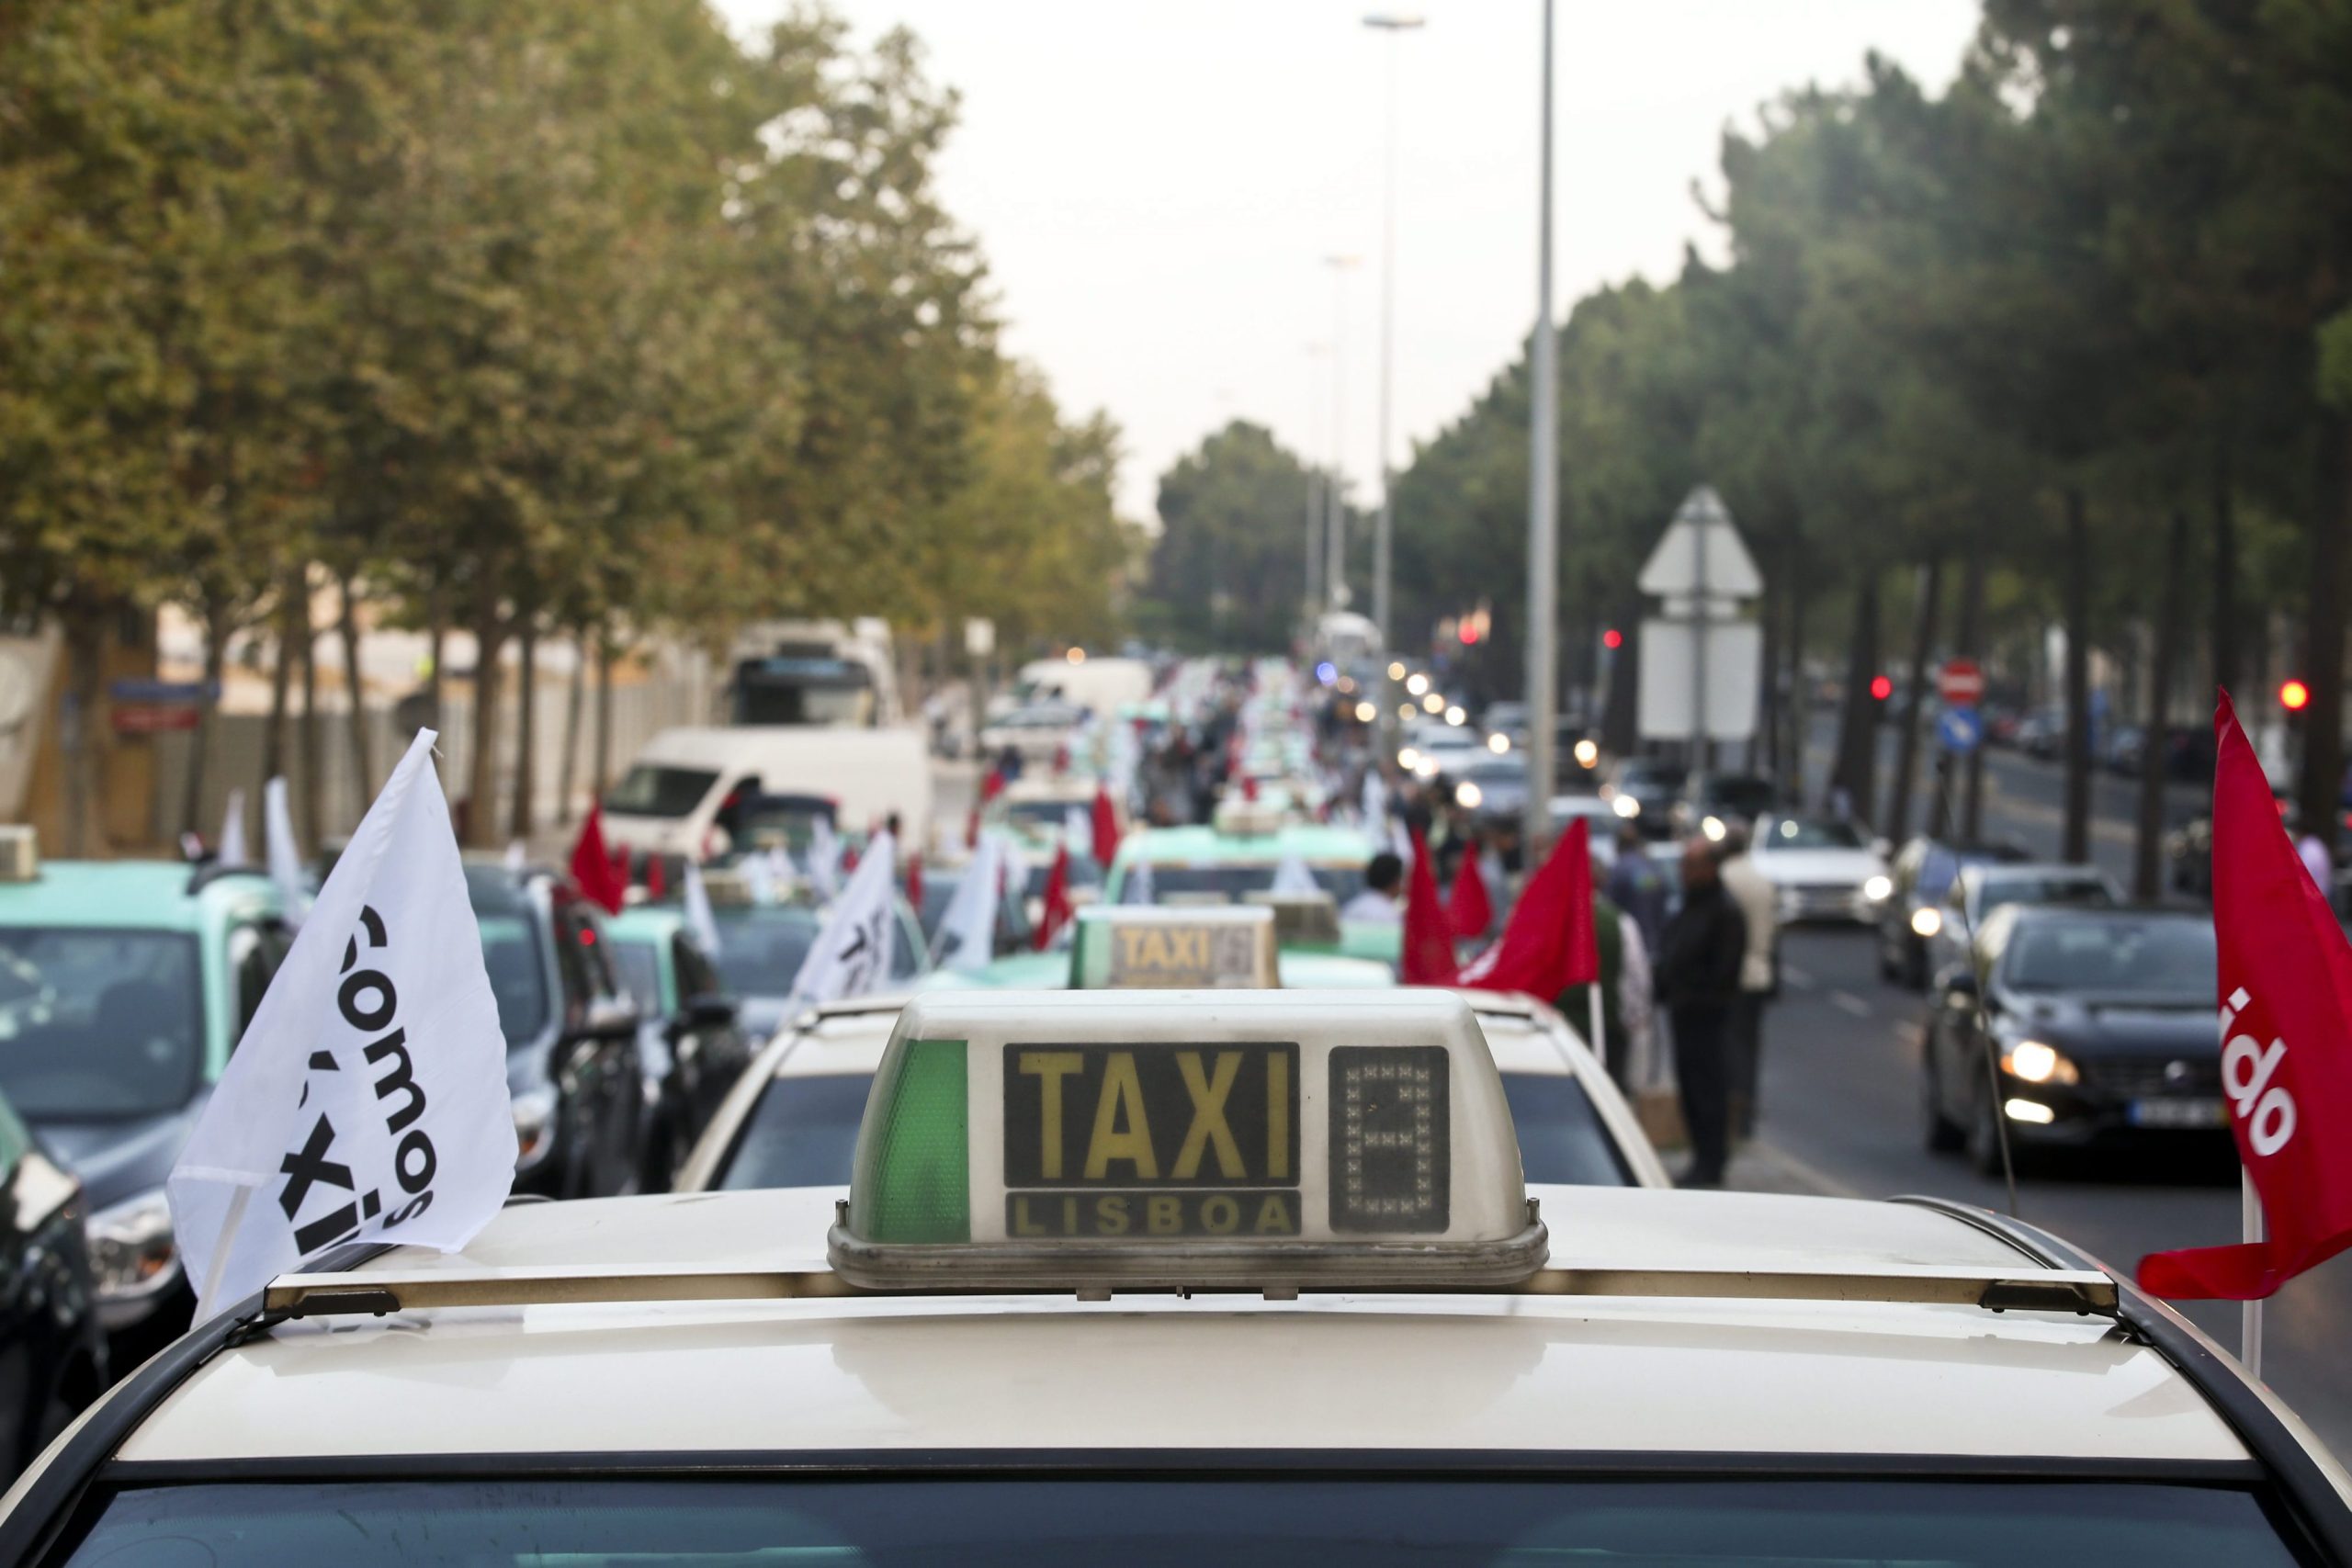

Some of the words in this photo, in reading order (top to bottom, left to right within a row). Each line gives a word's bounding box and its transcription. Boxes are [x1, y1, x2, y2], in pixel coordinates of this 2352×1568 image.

[1119, 926, 1210, 969] TAXI
[1019, 1051, 1290, 1179] TAXI
[1014, 1194, 1294, 1236] LISBOA
